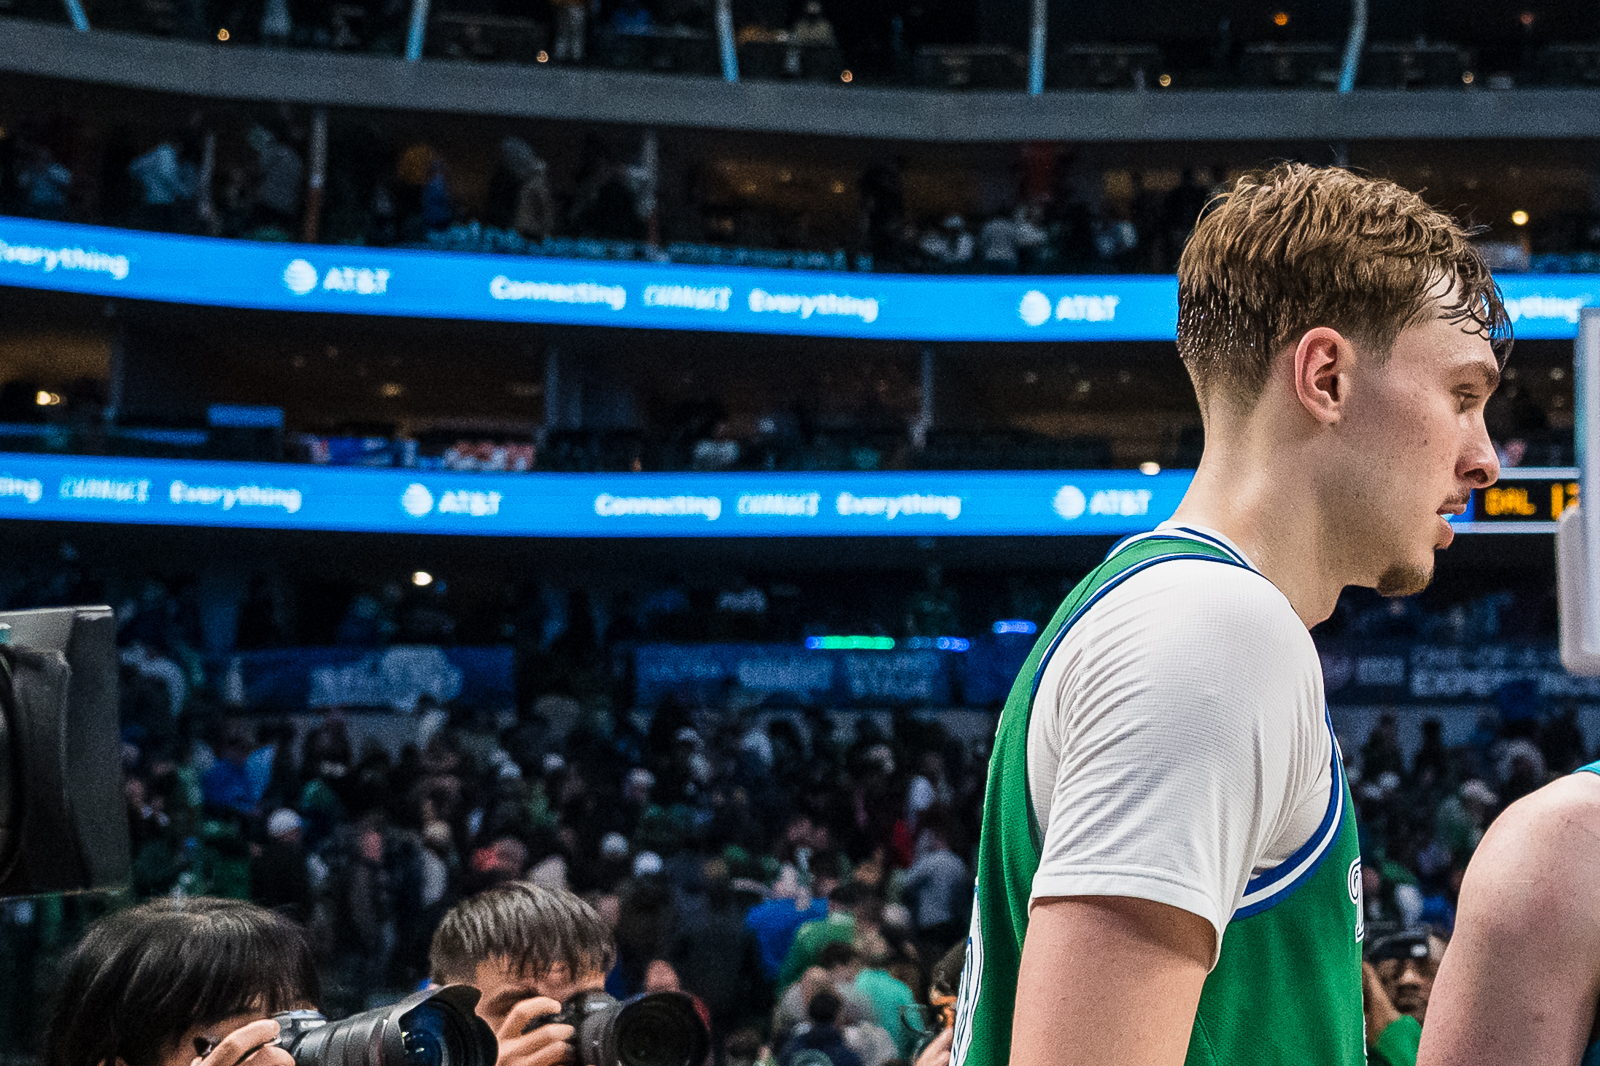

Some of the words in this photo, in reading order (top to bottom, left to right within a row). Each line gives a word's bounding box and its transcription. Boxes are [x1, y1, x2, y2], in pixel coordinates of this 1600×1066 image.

[323, 267, 390, 294] AT&T
[1056, 294, 1120, 322] AT&T
[439, 490, 502, 516] AT&T
[1089, 489, 1152, 516] AT&T
